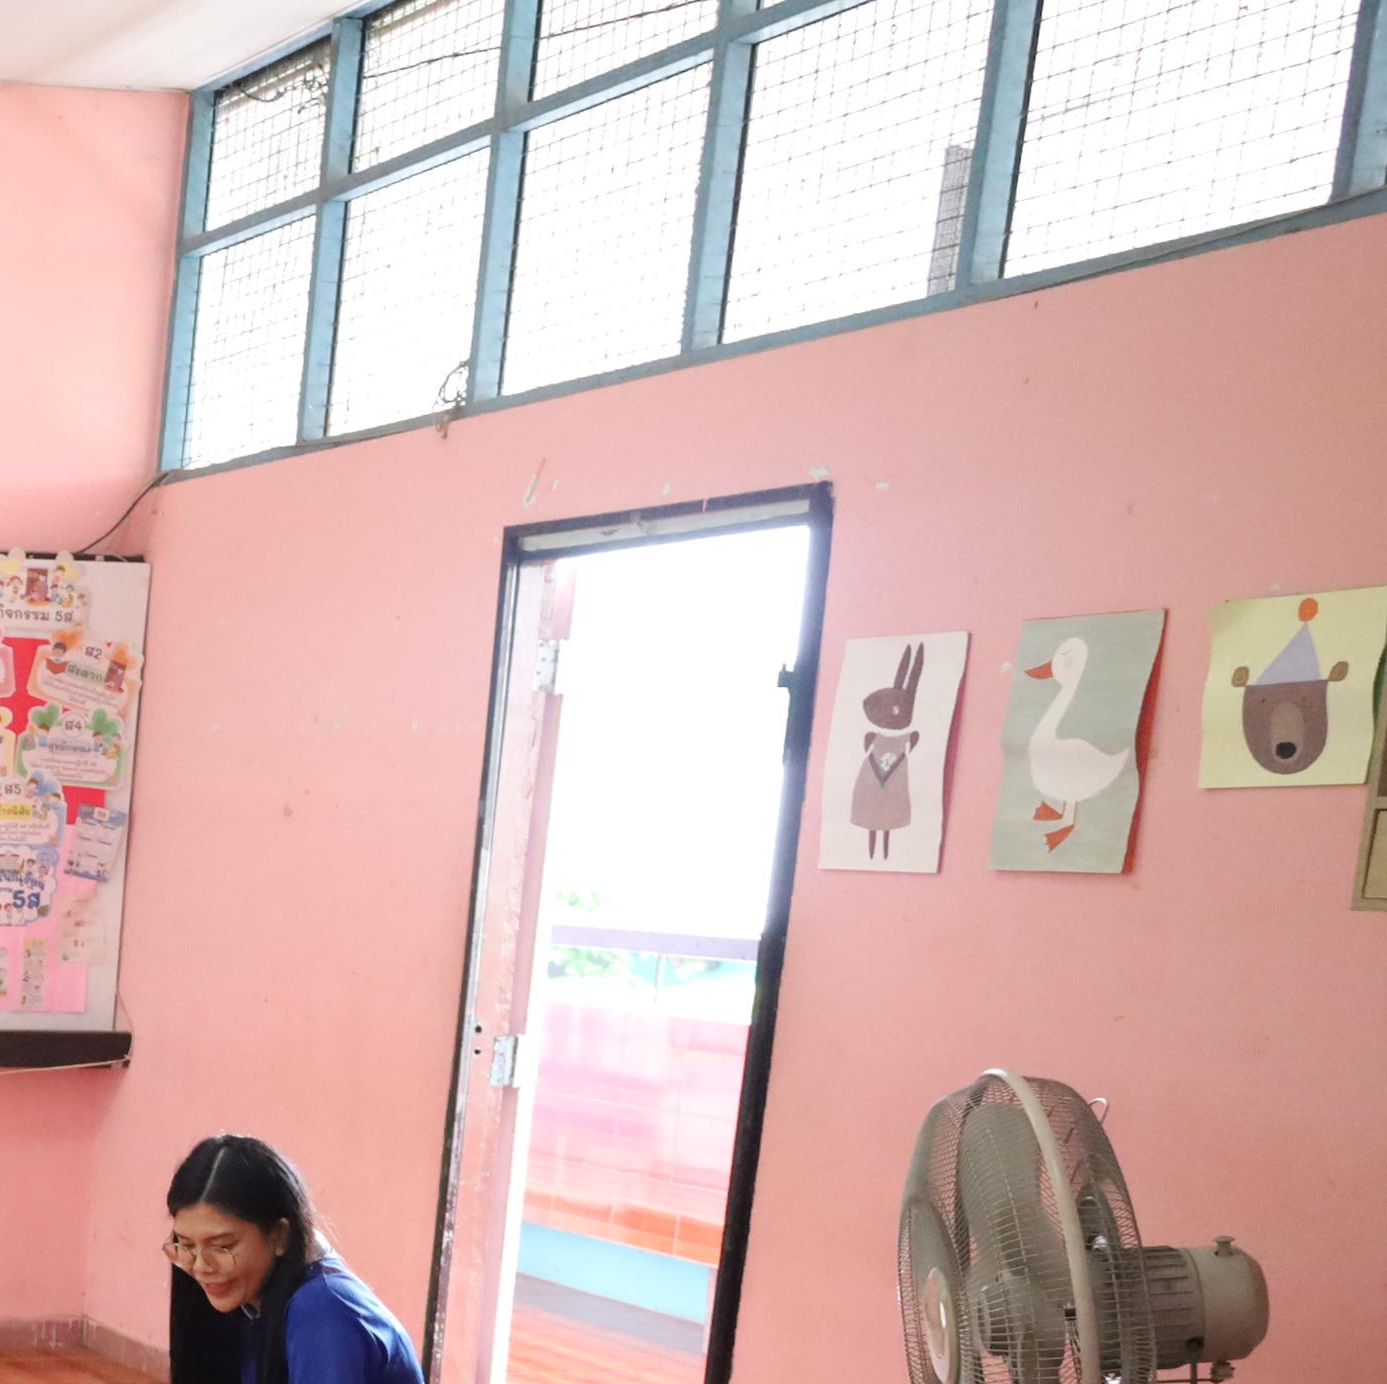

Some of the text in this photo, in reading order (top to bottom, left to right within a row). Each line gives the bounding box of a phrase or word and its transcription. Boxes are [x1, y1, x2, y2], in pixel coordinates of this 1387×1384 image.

[55, 610, 74, 622] 5ส
[84, 646, 103, 660] ส2
[4, 784, 22, 795] ส5
[12, 889, 41, 909] 5ส
